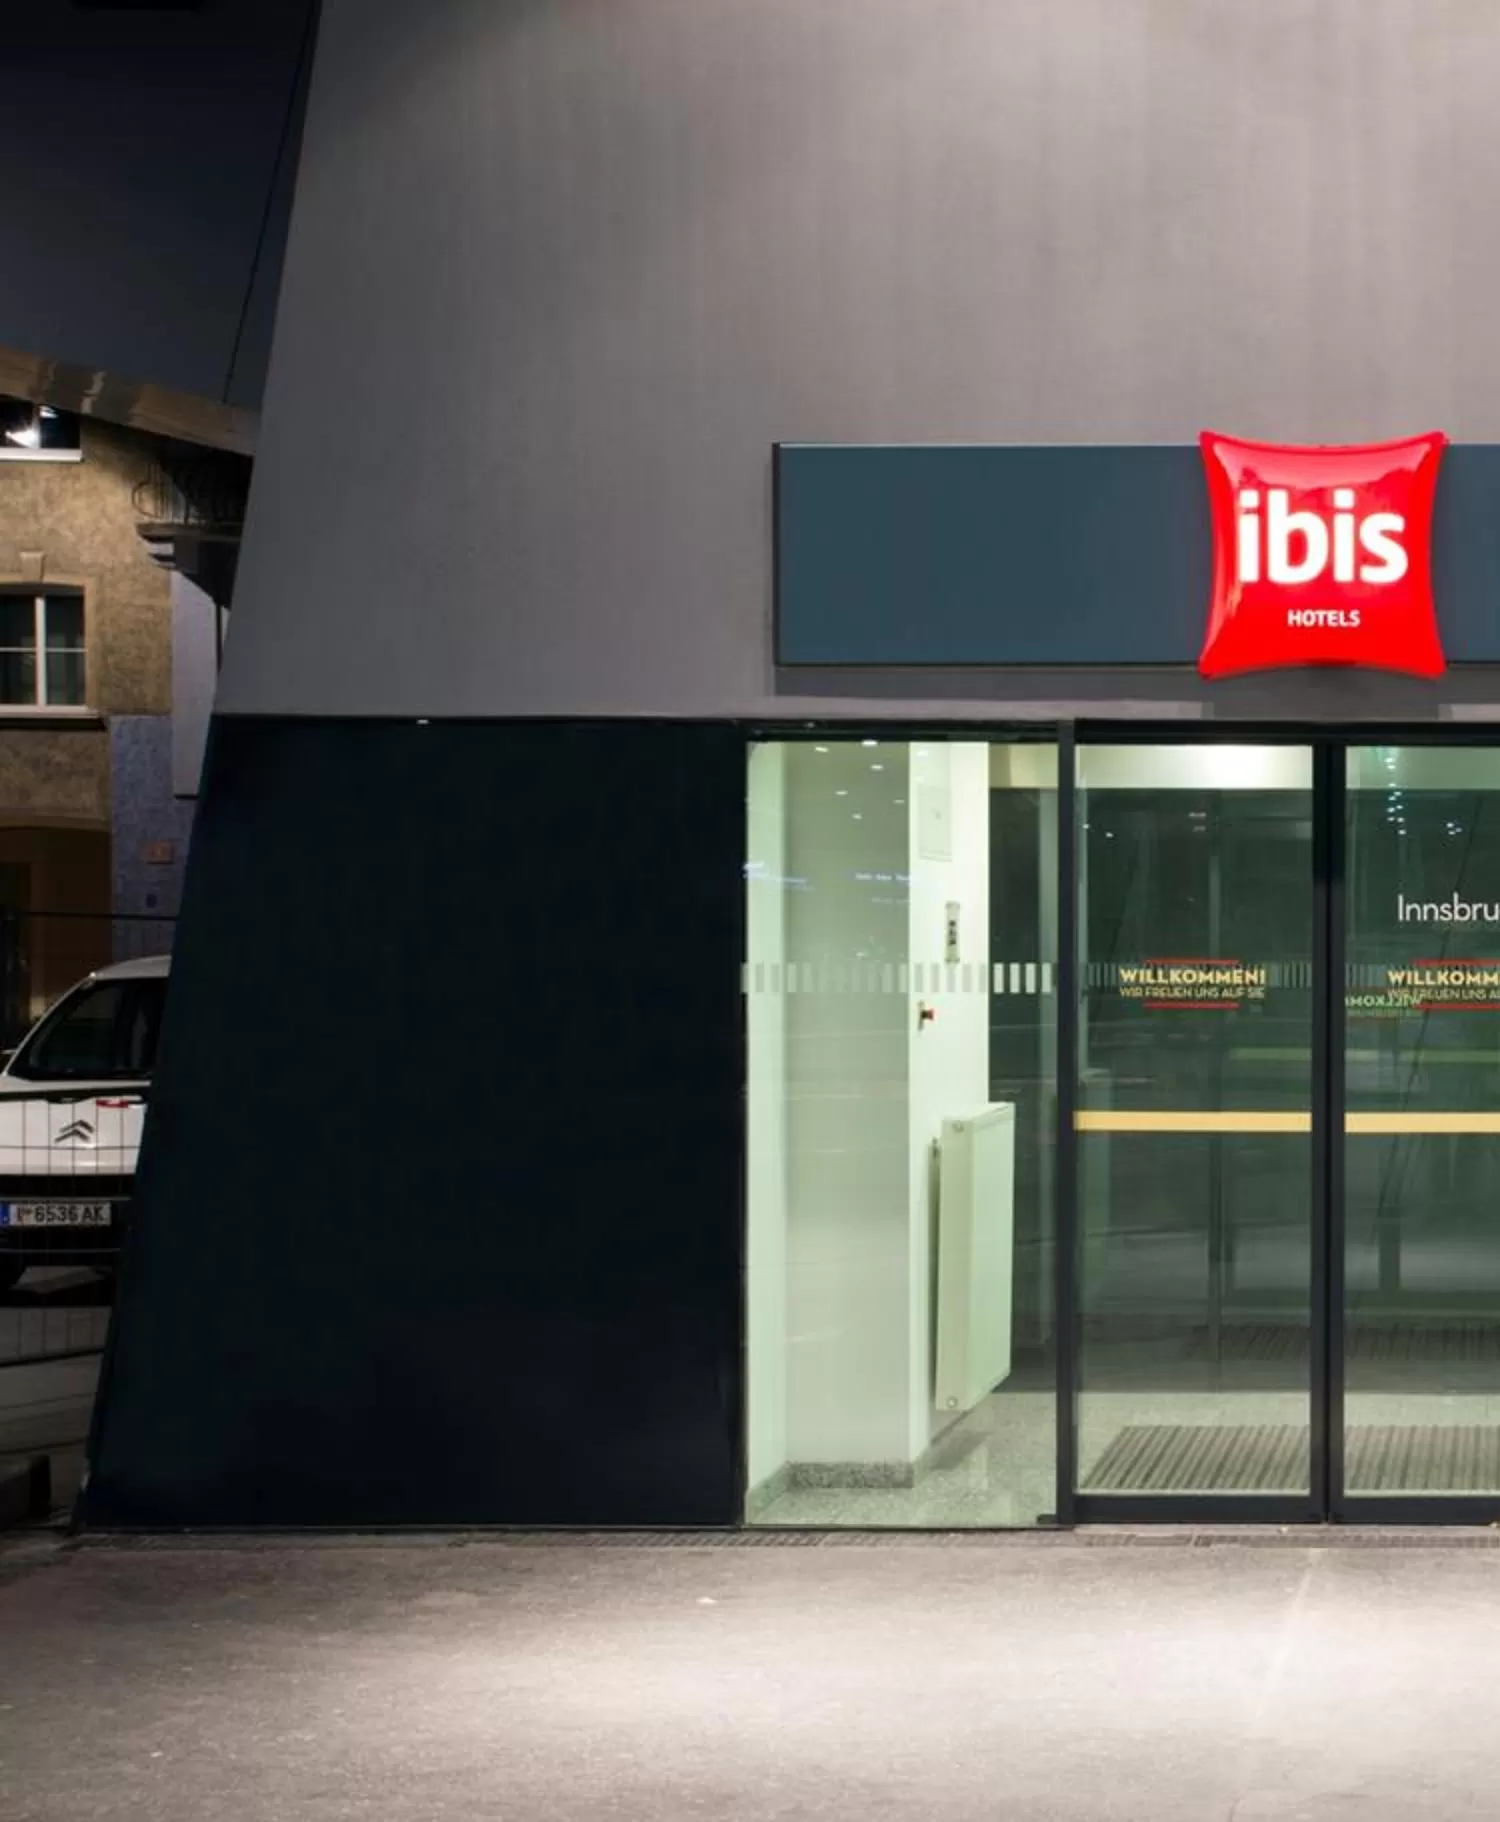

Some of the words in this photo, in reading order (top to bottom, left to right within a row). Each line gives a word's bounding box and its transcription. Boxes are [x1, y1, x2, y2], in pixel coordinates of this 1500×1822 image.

[1237, 488, 1408, 584] ibis
[1287, 608, 1360, 627] HOTELS
[1119, 968, 1265, 984] WILLKOMMEN!
[1119, 987, 1143, 998] WIR
[1145, 987, 1192, 998] FREUEN
[1195, 987, 1220, 998] UNS
[1221, 987, 1245, 998] AUF
[1462, 988, 1487, 999] UNS
